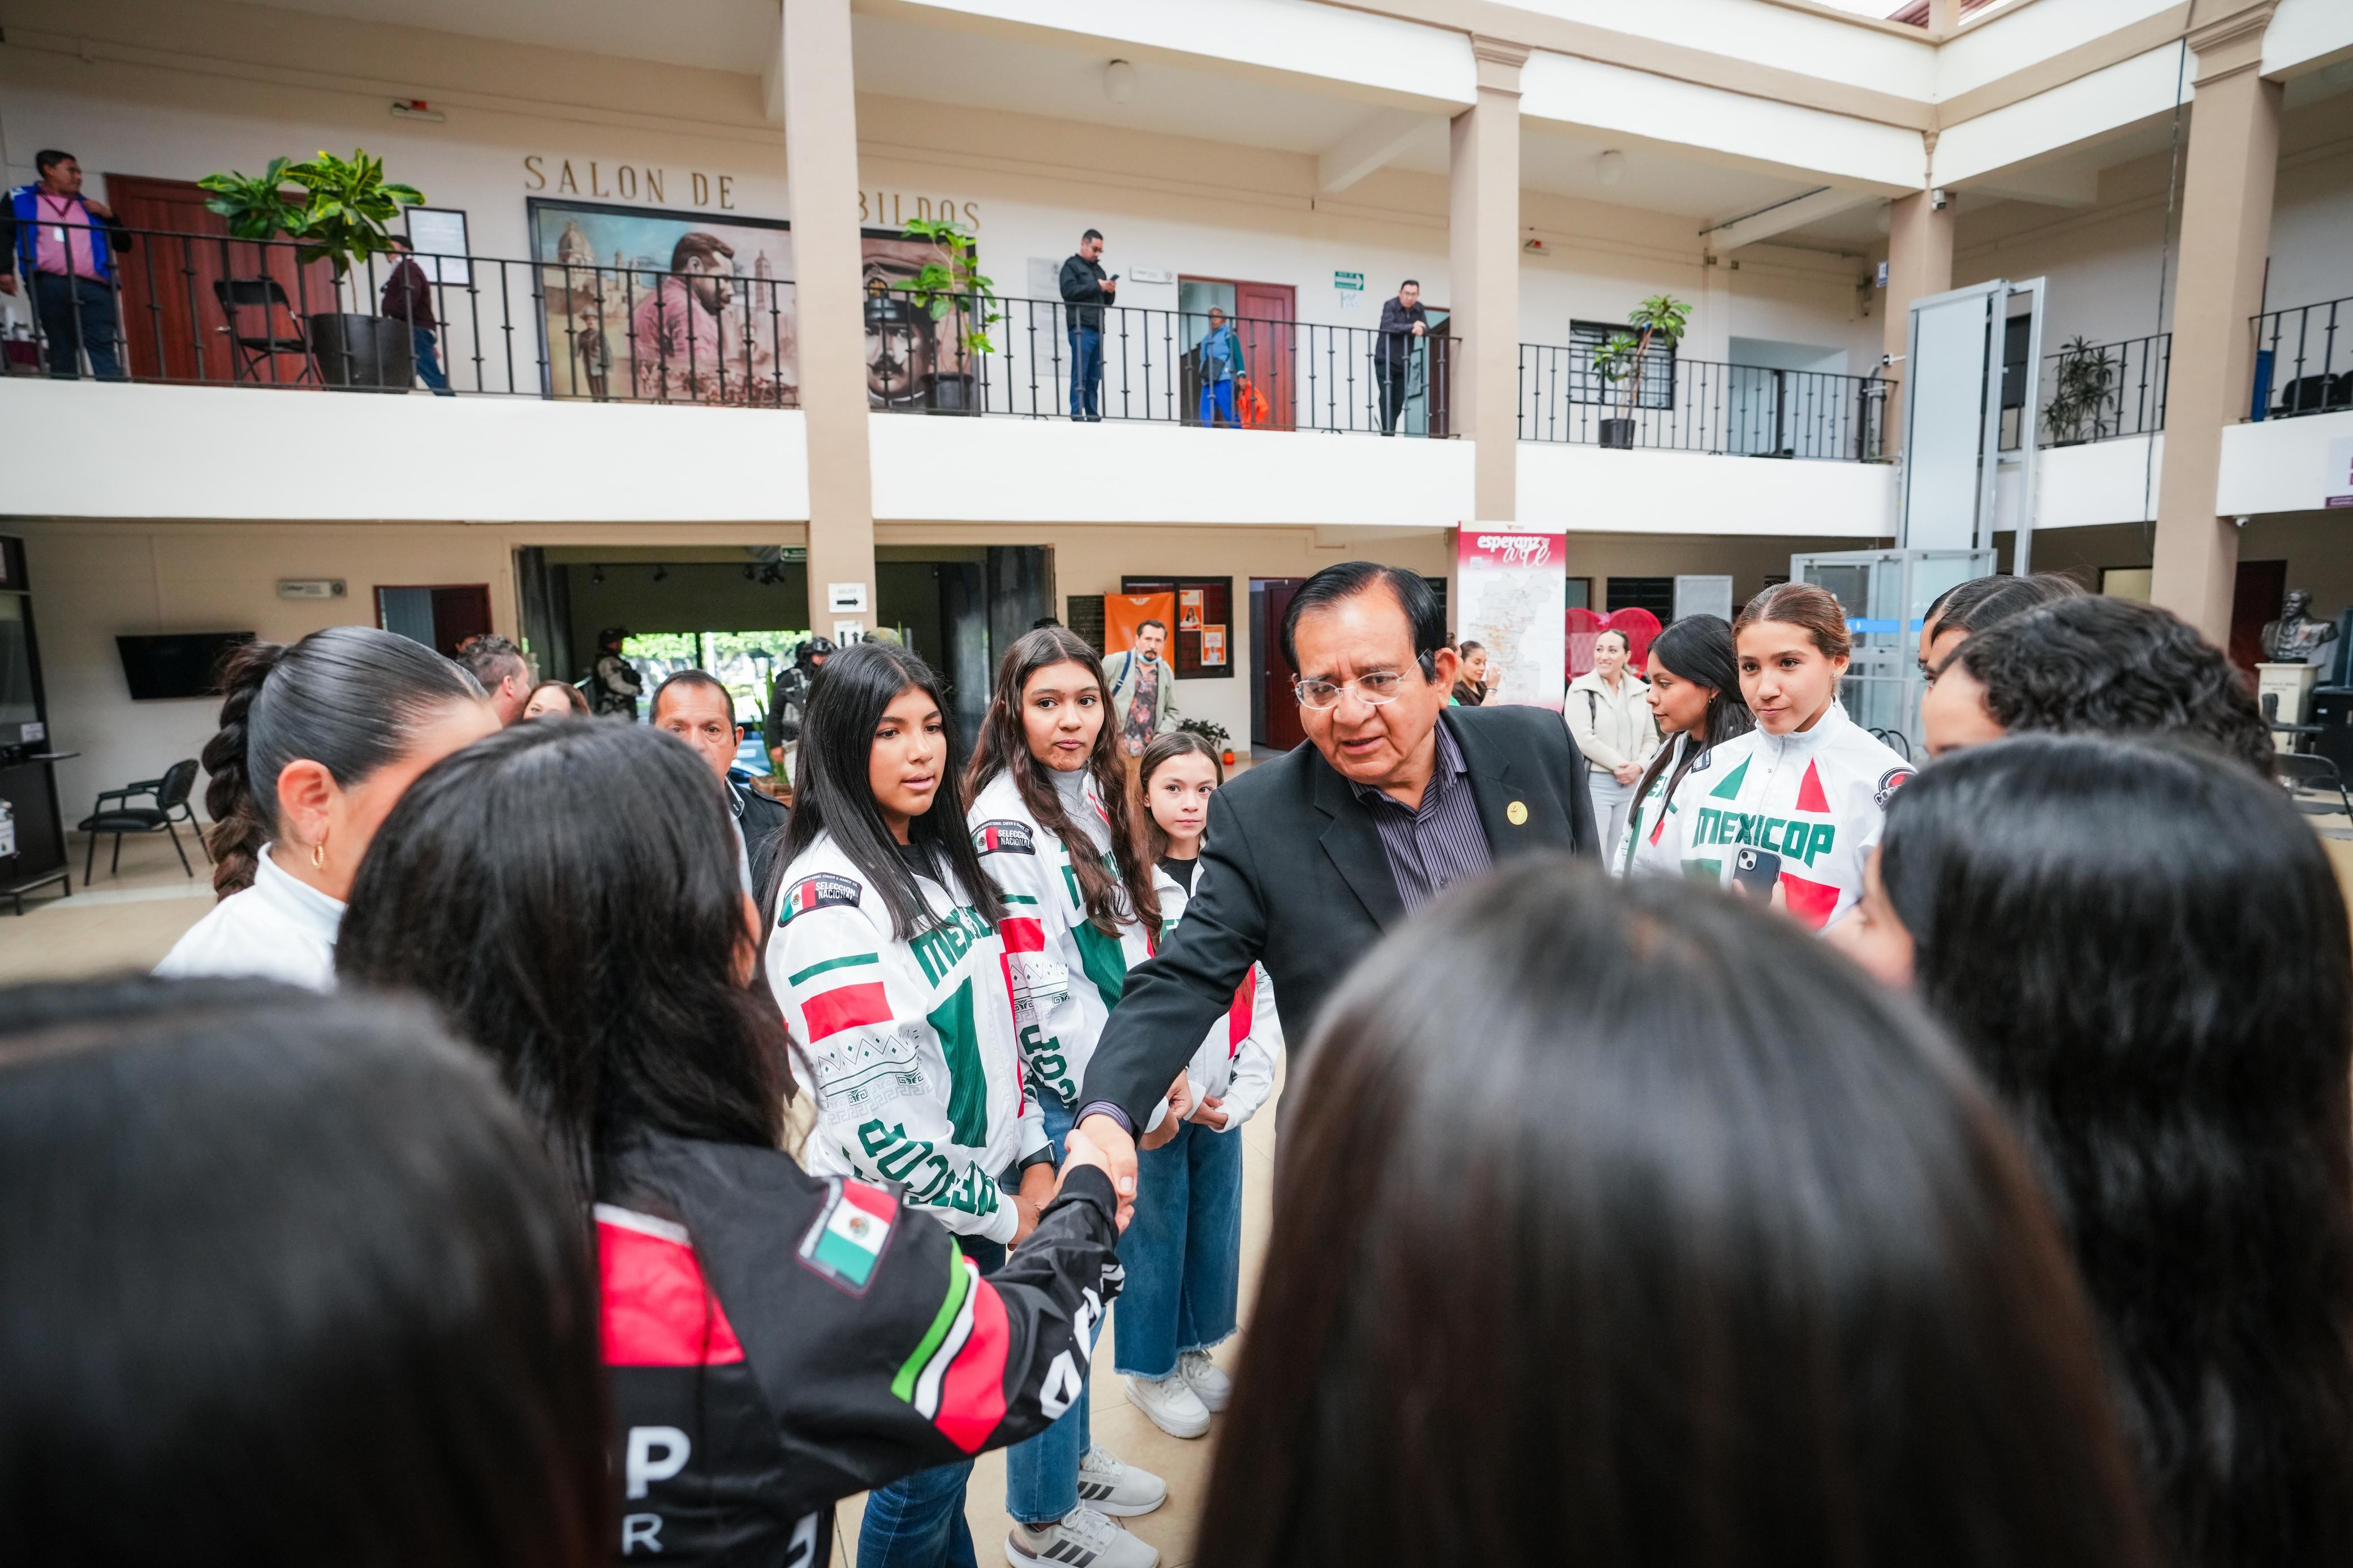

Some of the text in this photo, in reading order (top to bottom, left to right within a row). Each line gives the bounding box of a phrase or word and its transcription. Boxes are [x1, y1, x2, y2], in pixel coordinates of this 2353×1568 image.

[524, 155, 980, 233] SALON DE BILDOS
[1001, 837, 1031, 848] NACIONAL
[1692, 807, 1835, 869] MEXICOP
[816, 882, 856, 896] SELECCION
